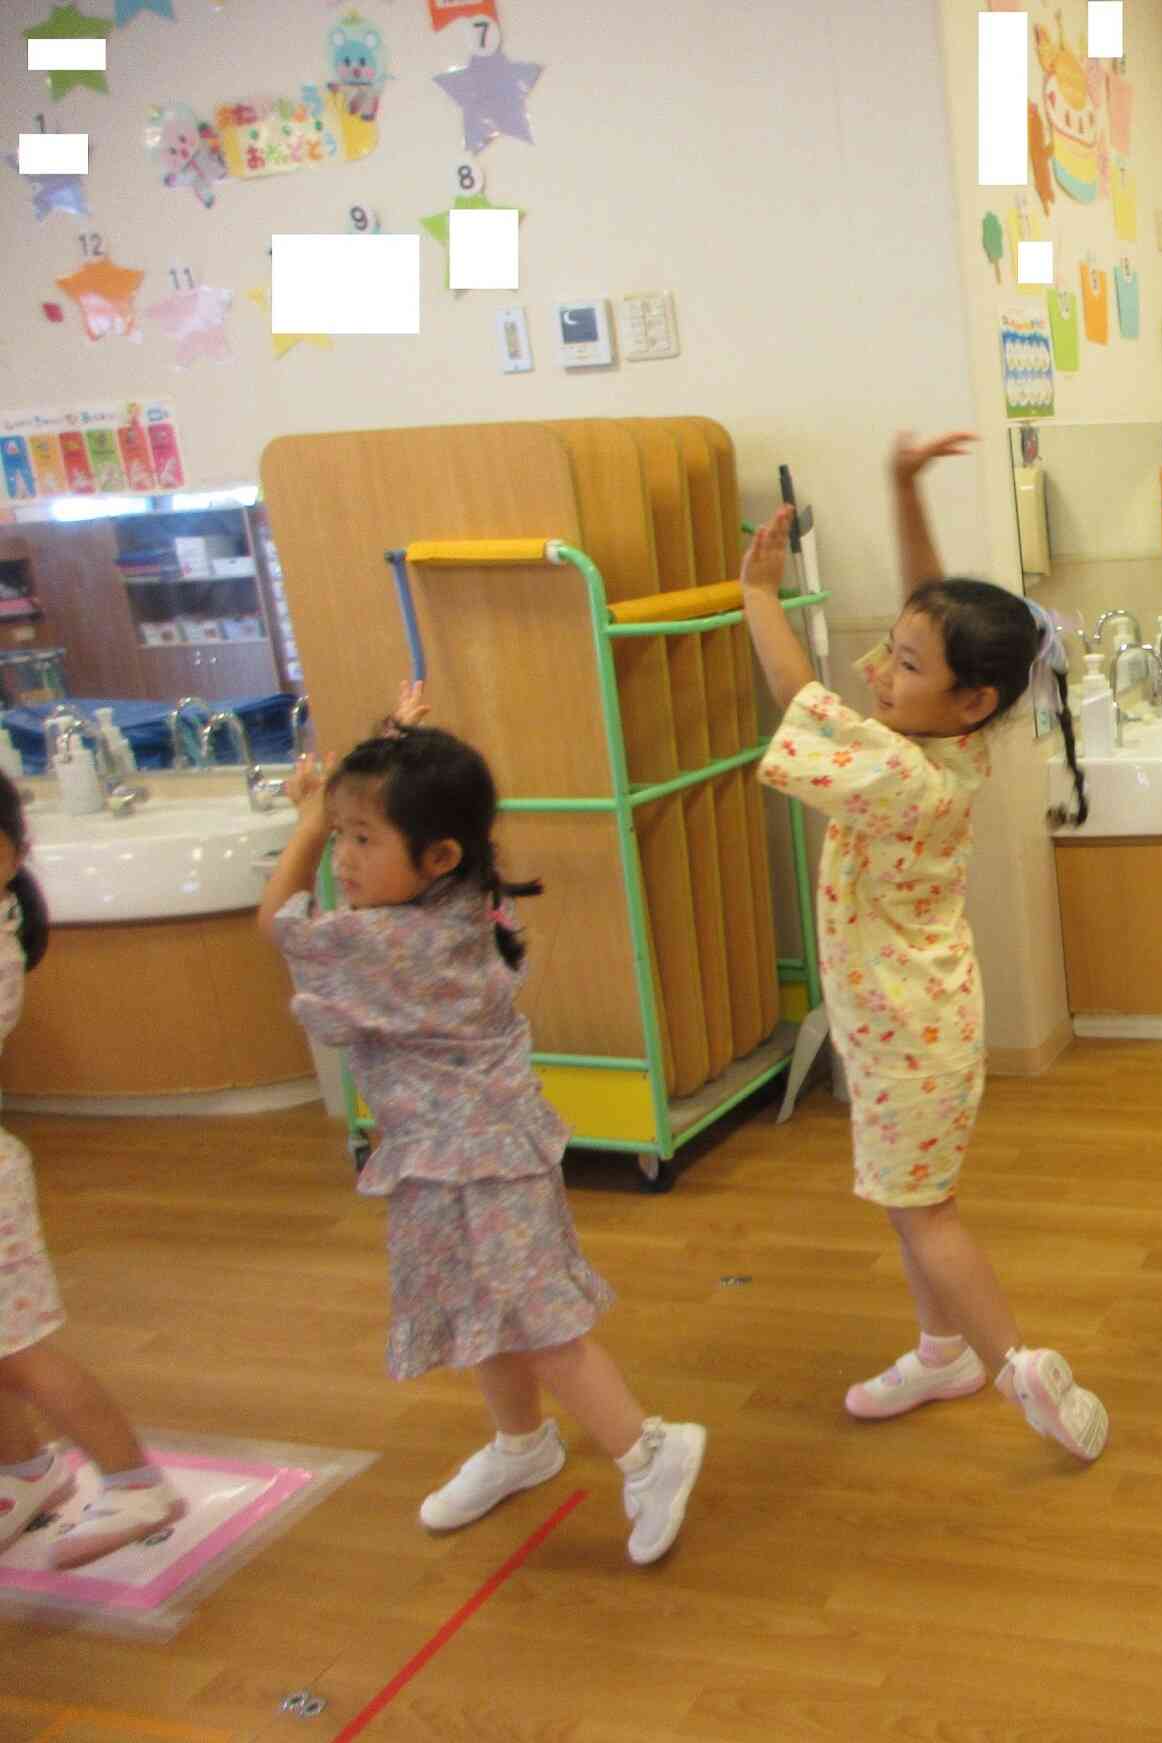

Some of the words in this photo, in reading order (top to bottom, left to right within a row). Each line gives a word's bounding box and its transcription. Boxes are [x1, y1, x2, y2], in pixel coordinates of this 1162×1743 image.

[473, 21, 489, 48] 7
[457, 165, 475, 190] 8
[351, 206, 368, 231] 9
[78, 233, 104, 256] 12
[169, 267, 194, 289] 11
